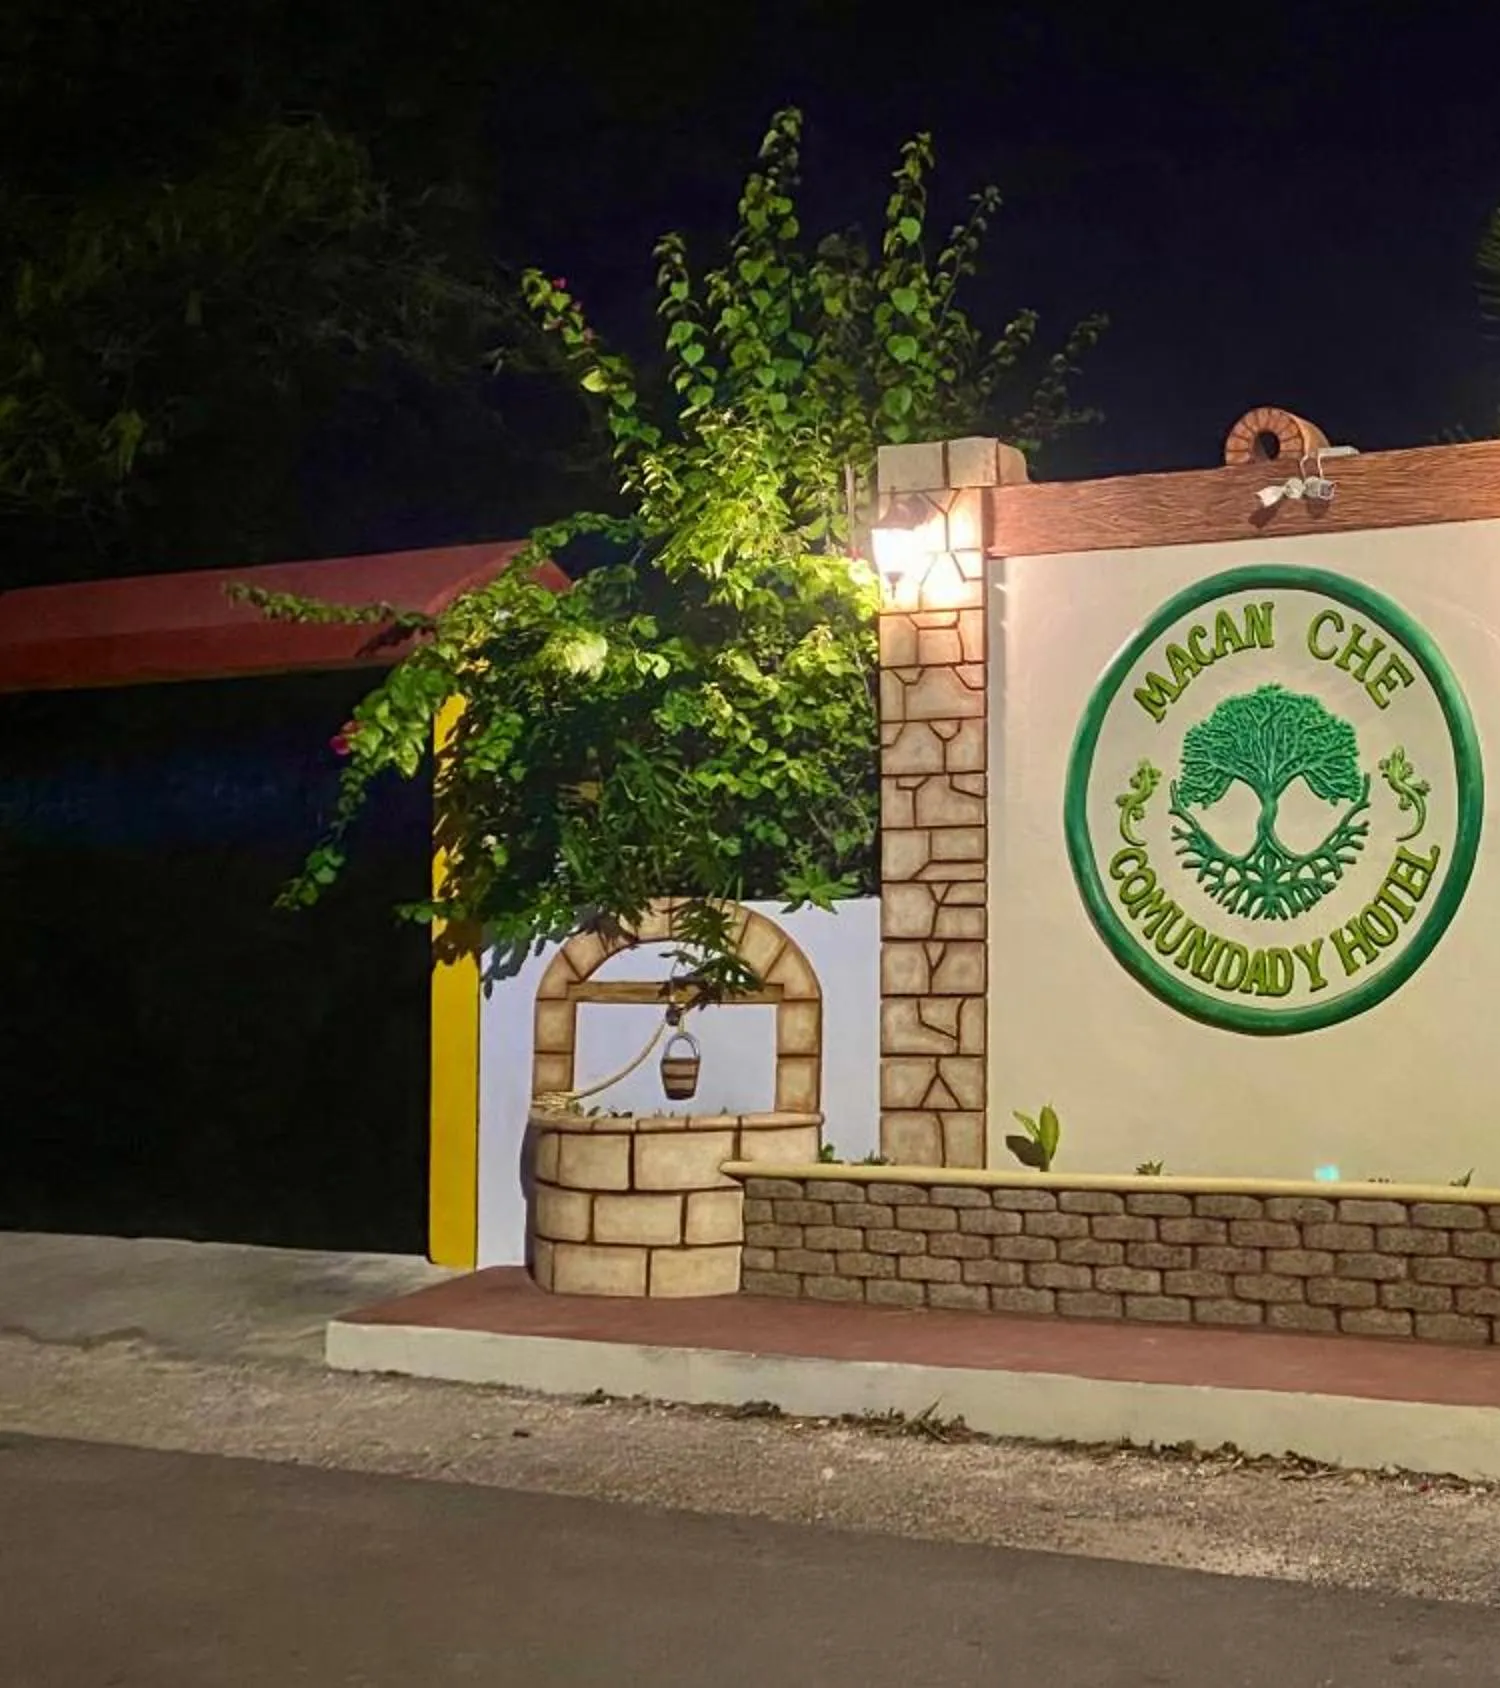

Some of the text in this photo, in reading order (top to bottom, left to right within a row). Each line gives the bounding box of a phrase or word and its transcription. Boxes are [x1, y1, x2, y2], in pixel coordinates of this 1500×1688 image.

[1133, 602, 1415, 722] MACAN CHE
[1330, 845, 1441, 976] HOTEL
